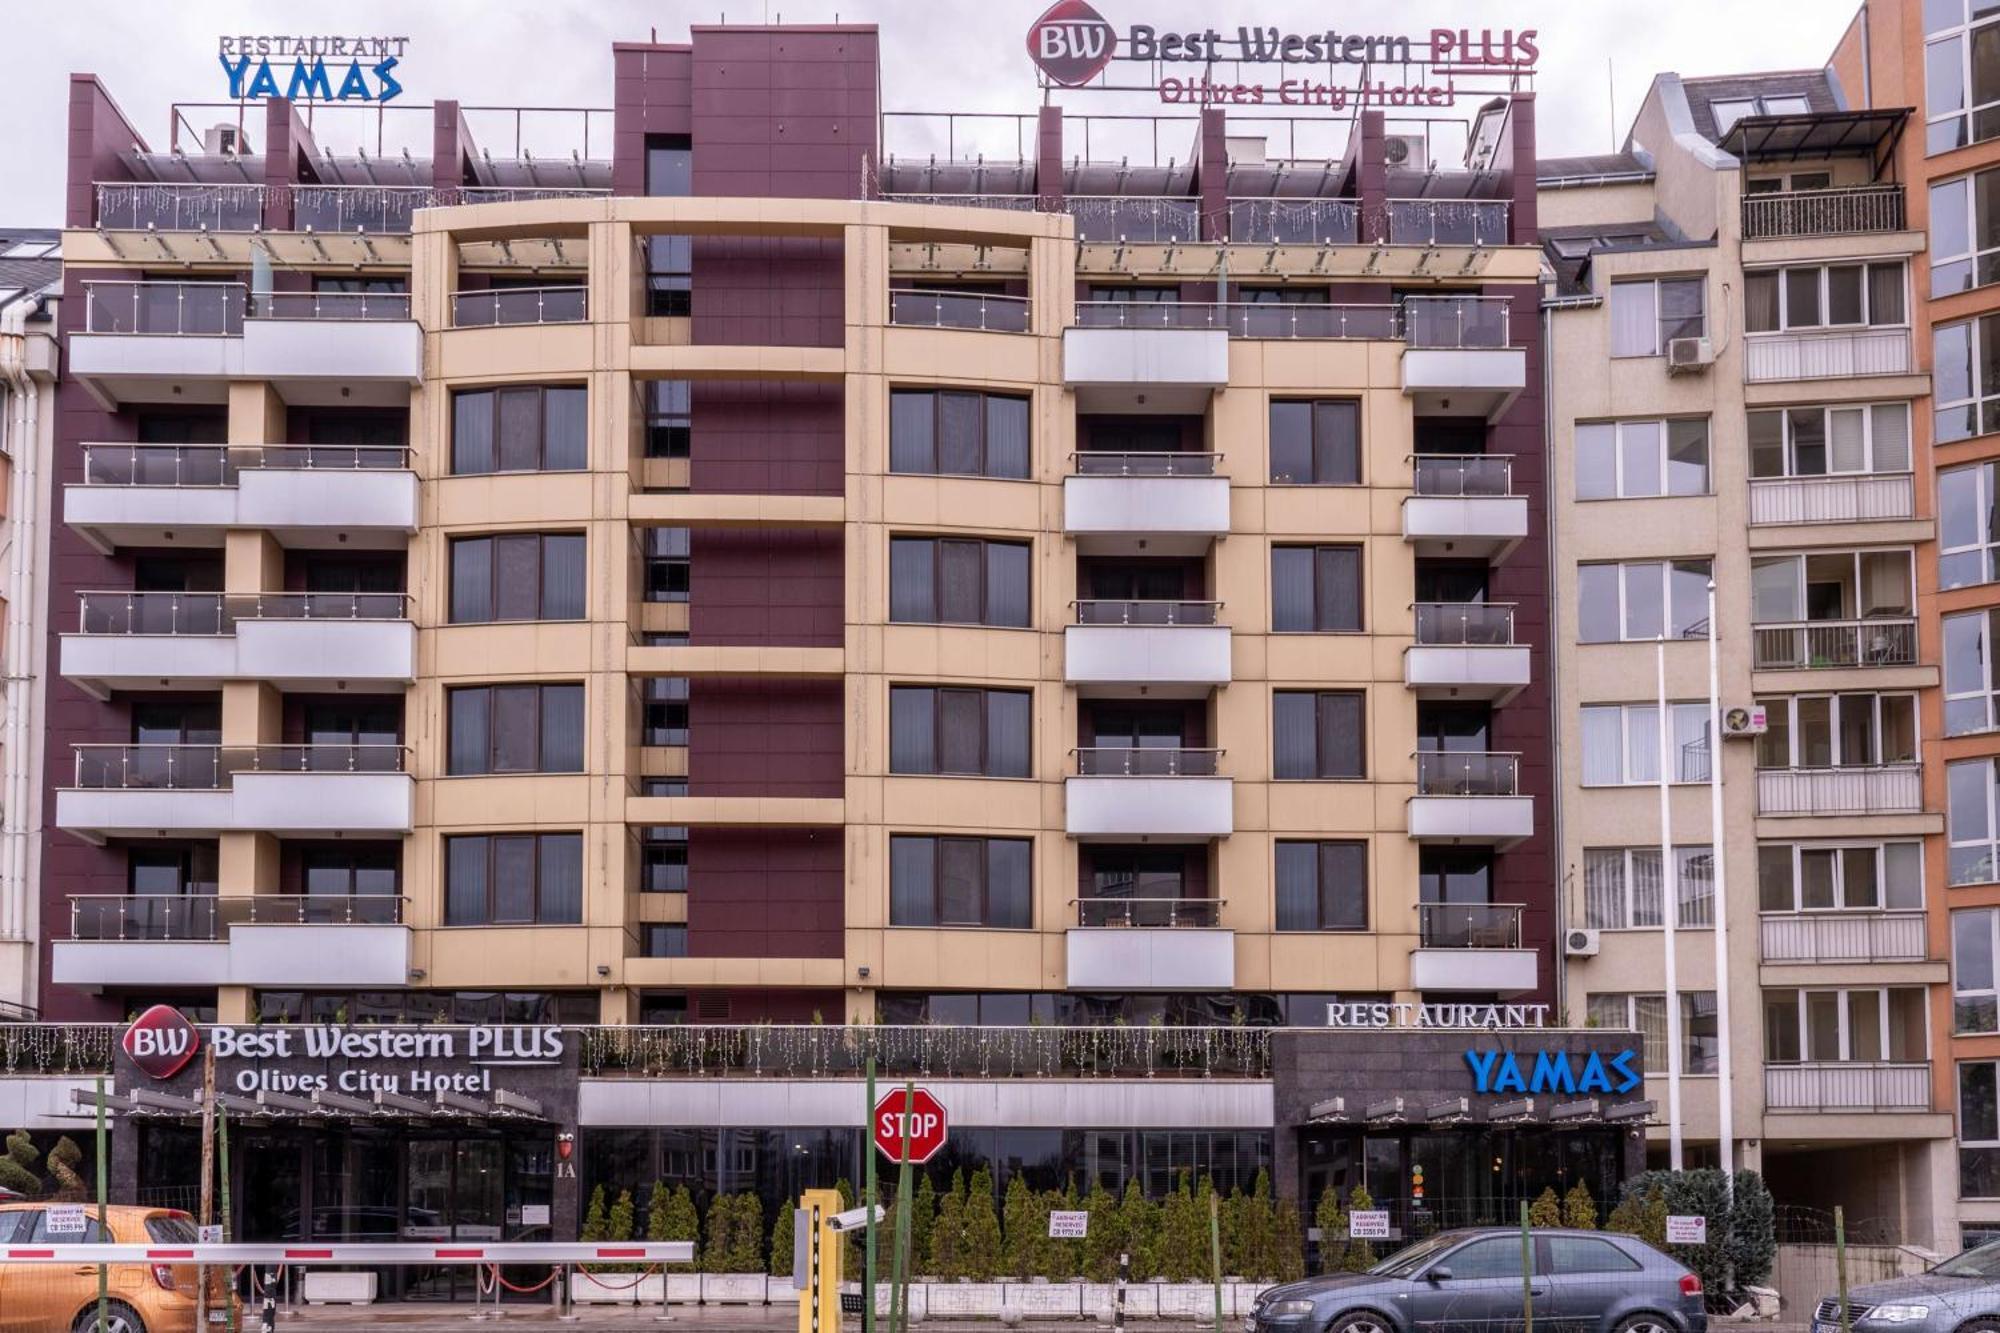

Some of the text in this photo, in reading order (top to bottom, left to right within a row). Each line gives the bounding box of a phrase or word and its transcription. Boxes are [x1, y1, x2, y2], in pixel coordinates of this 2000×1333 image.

[219, 35, 409, 56] RESTAURANT
[1040, 26, 1106, 59] BW
[1130, 25, 1539, 66] Best Western PLUS
[219, 53, 403, 102] YAMAS
[1160, 77, 1455, 111] Olives City Hotel
[1327, 1003, 1549, 1028] RESTAURANT
[134, 1028, 188, 1057] BW
[211, 1027, 564, 1058] Best Western PLUS
[236, 1069, 491, 1094] Olives City Hotel
[1464, 1049, 1642, 1094] YAMAS
[881, 1112, 937, 1138] STOP
[557, 1163, 576, 1178] 1A
